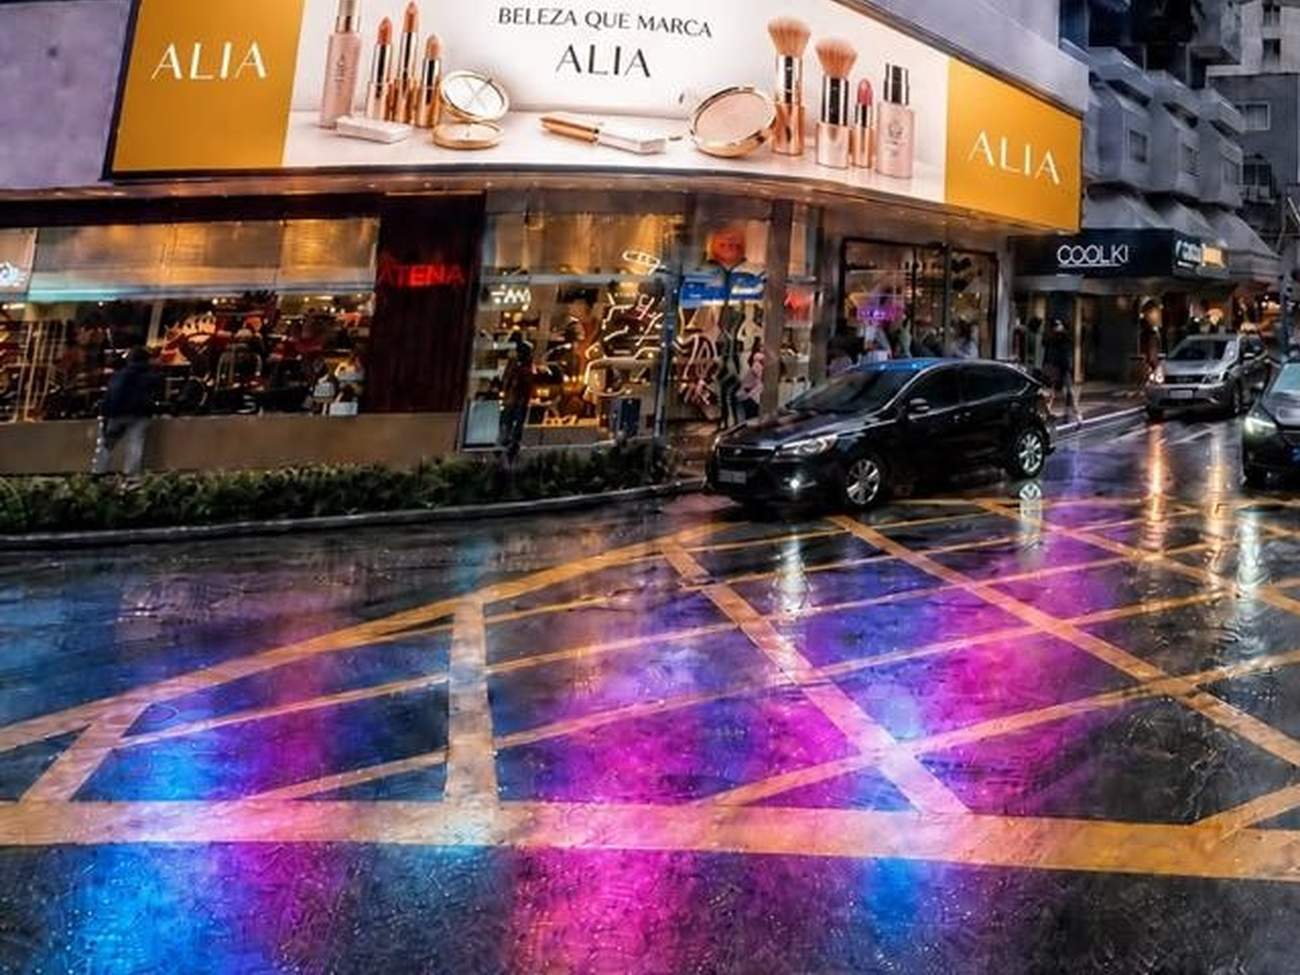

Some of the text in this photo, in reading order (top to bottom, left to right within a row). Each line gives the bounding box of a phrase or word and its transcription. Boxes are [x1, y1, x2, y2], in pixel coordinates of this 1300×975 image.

[498, 7, 713, 38] BELEZA QUE MARCA
[150, 42, 268, 81] ALIA
[555, 44, 651, 78] ALIA
[967, 130, 1061, 186] ALIA
